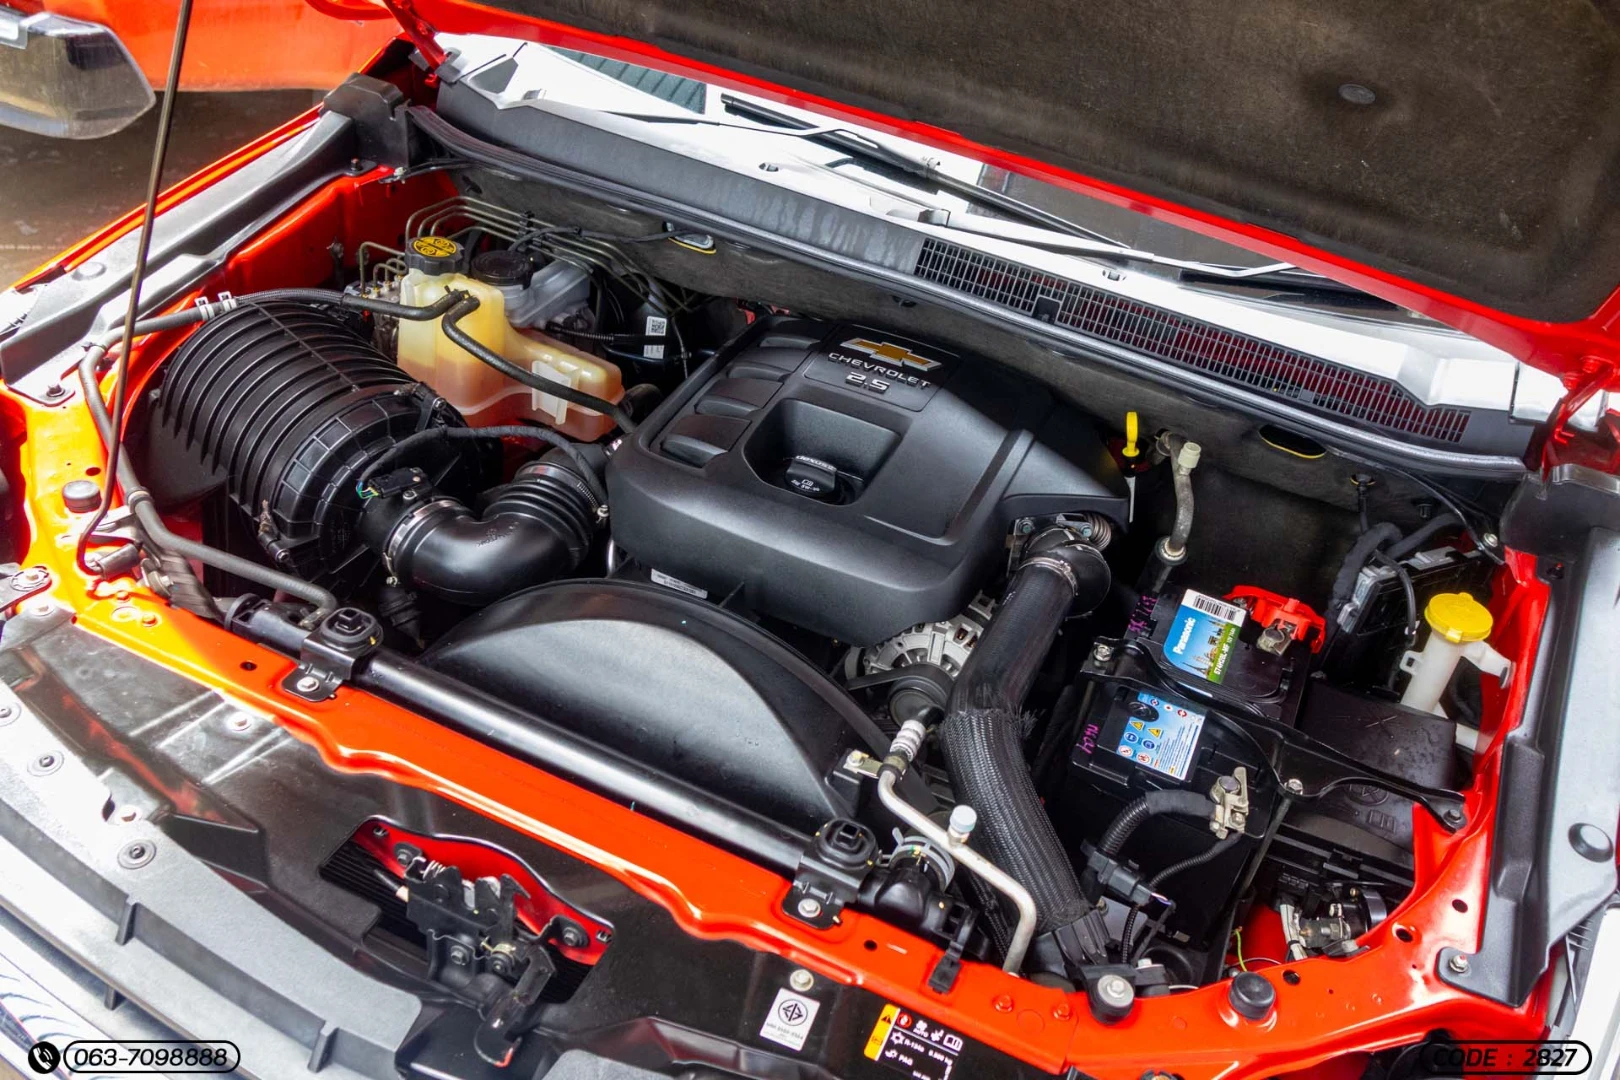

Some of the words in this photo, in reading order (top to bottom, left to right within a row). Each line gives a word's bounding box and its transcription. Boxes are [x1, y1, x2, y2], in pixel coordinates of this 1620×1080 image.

[828, 352, 931, 388] CHEVROLET
[846, 371, 890, 392] 2.5
[1172, 617, 1196, 655] Panasonic
